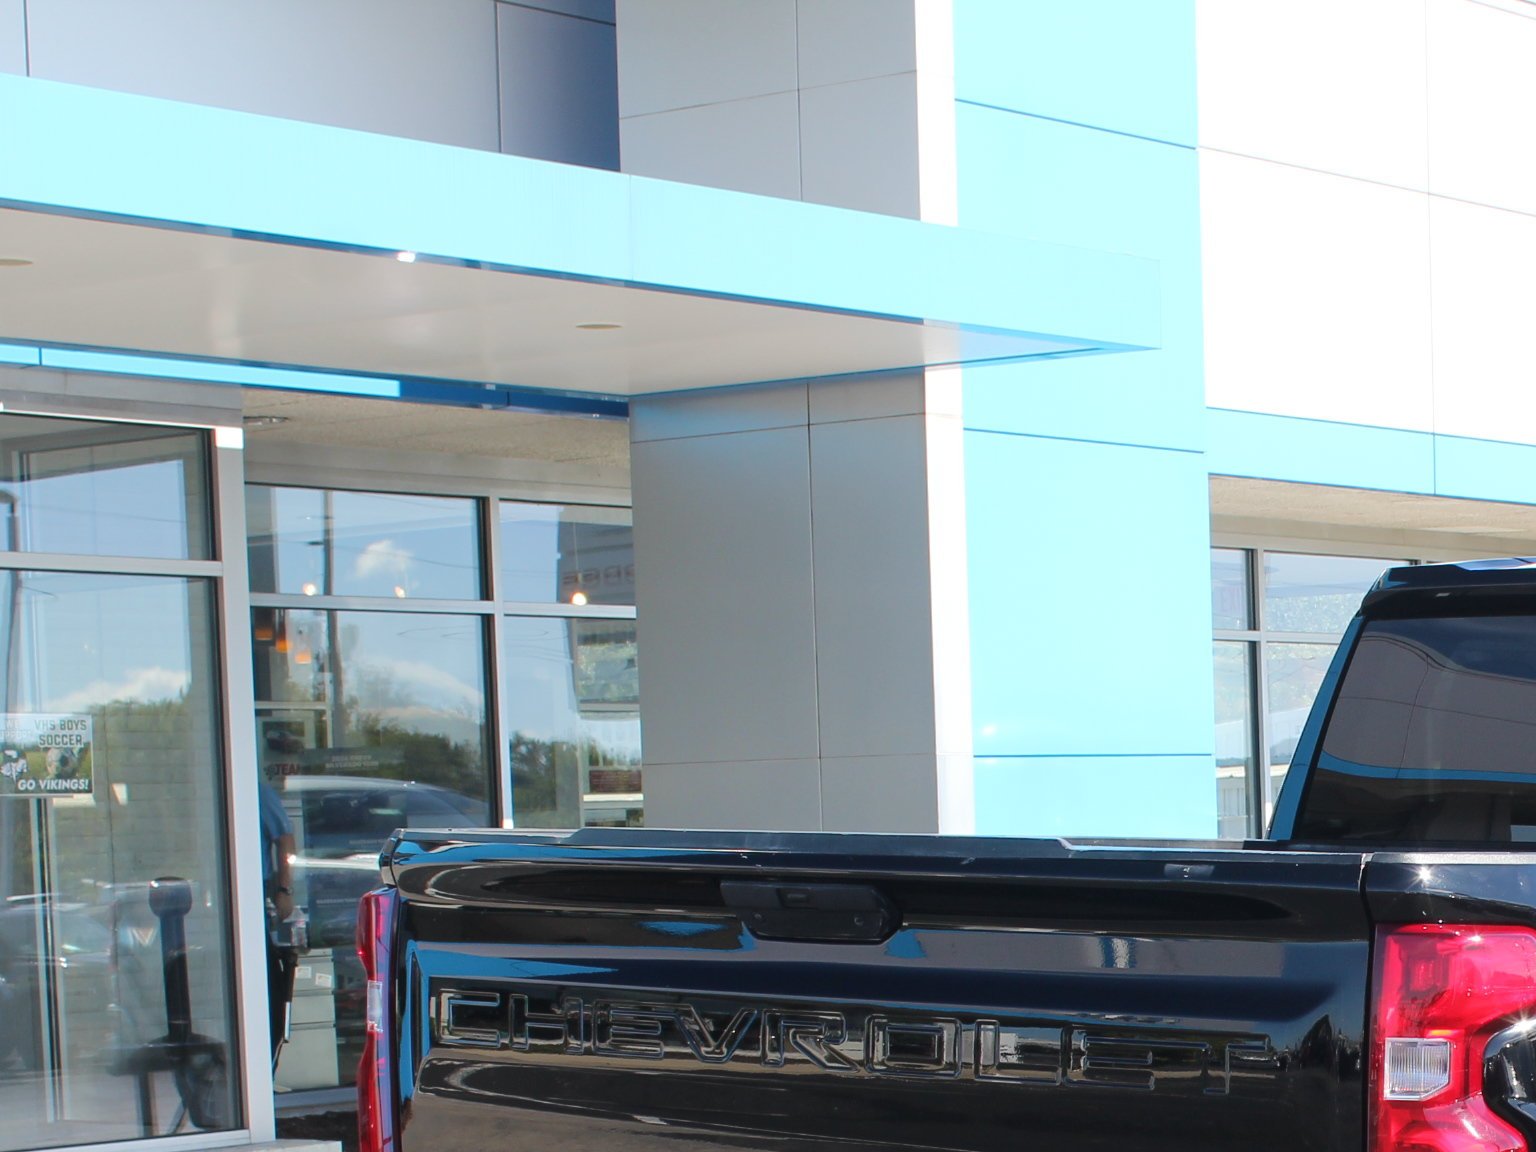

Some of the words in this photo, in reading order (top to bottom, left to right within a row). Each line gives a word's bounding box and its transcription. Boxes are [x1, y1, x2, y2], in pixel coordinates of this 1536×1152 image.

[34, 719, 56, 731] VHS
[59, 719, 87, 731] BOYS
[38, 733, 83, 747] SOCCER
[17, 779, 36, 791] GO
[39, 779, 89, 790] VIKINGS!
[435, 987, 1272, 1096] CHEVROLET
